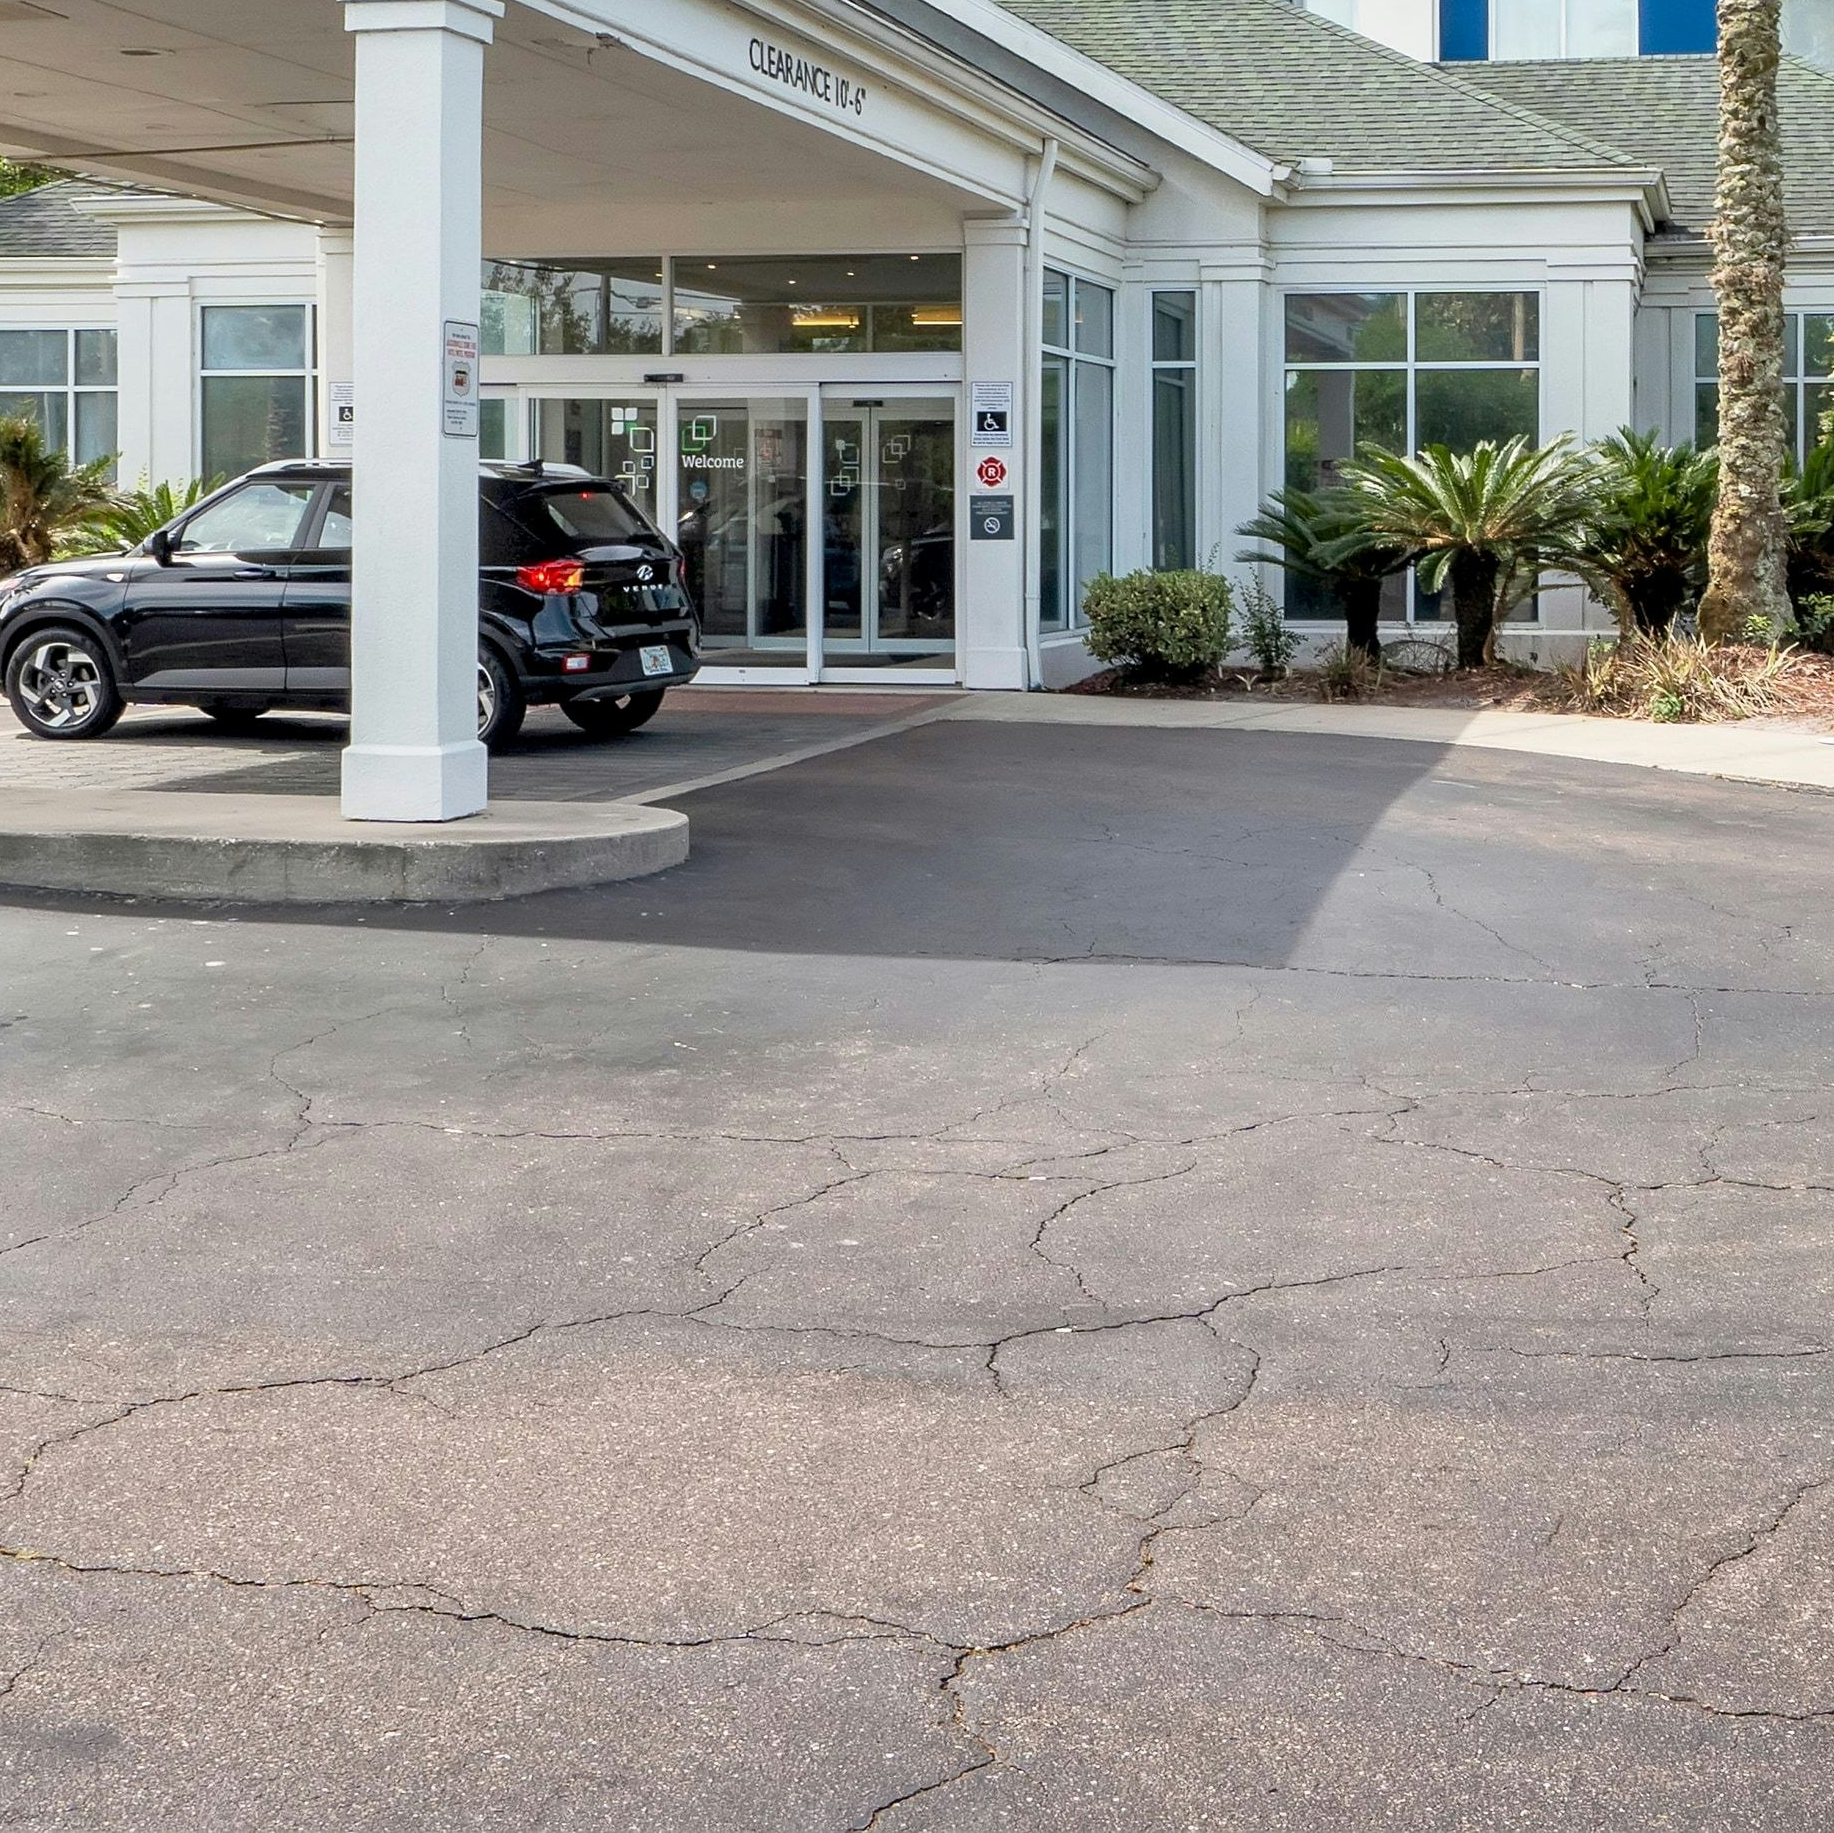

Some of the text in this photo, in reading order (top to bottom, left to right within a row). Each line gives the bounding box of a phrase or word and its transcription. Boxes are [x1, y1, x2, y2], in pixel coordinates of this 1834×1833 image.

[749, 37, 831, 103] CLEARANCE
[681, 453, 745, 469] Welcome
[987, 467, 997, 477] R
